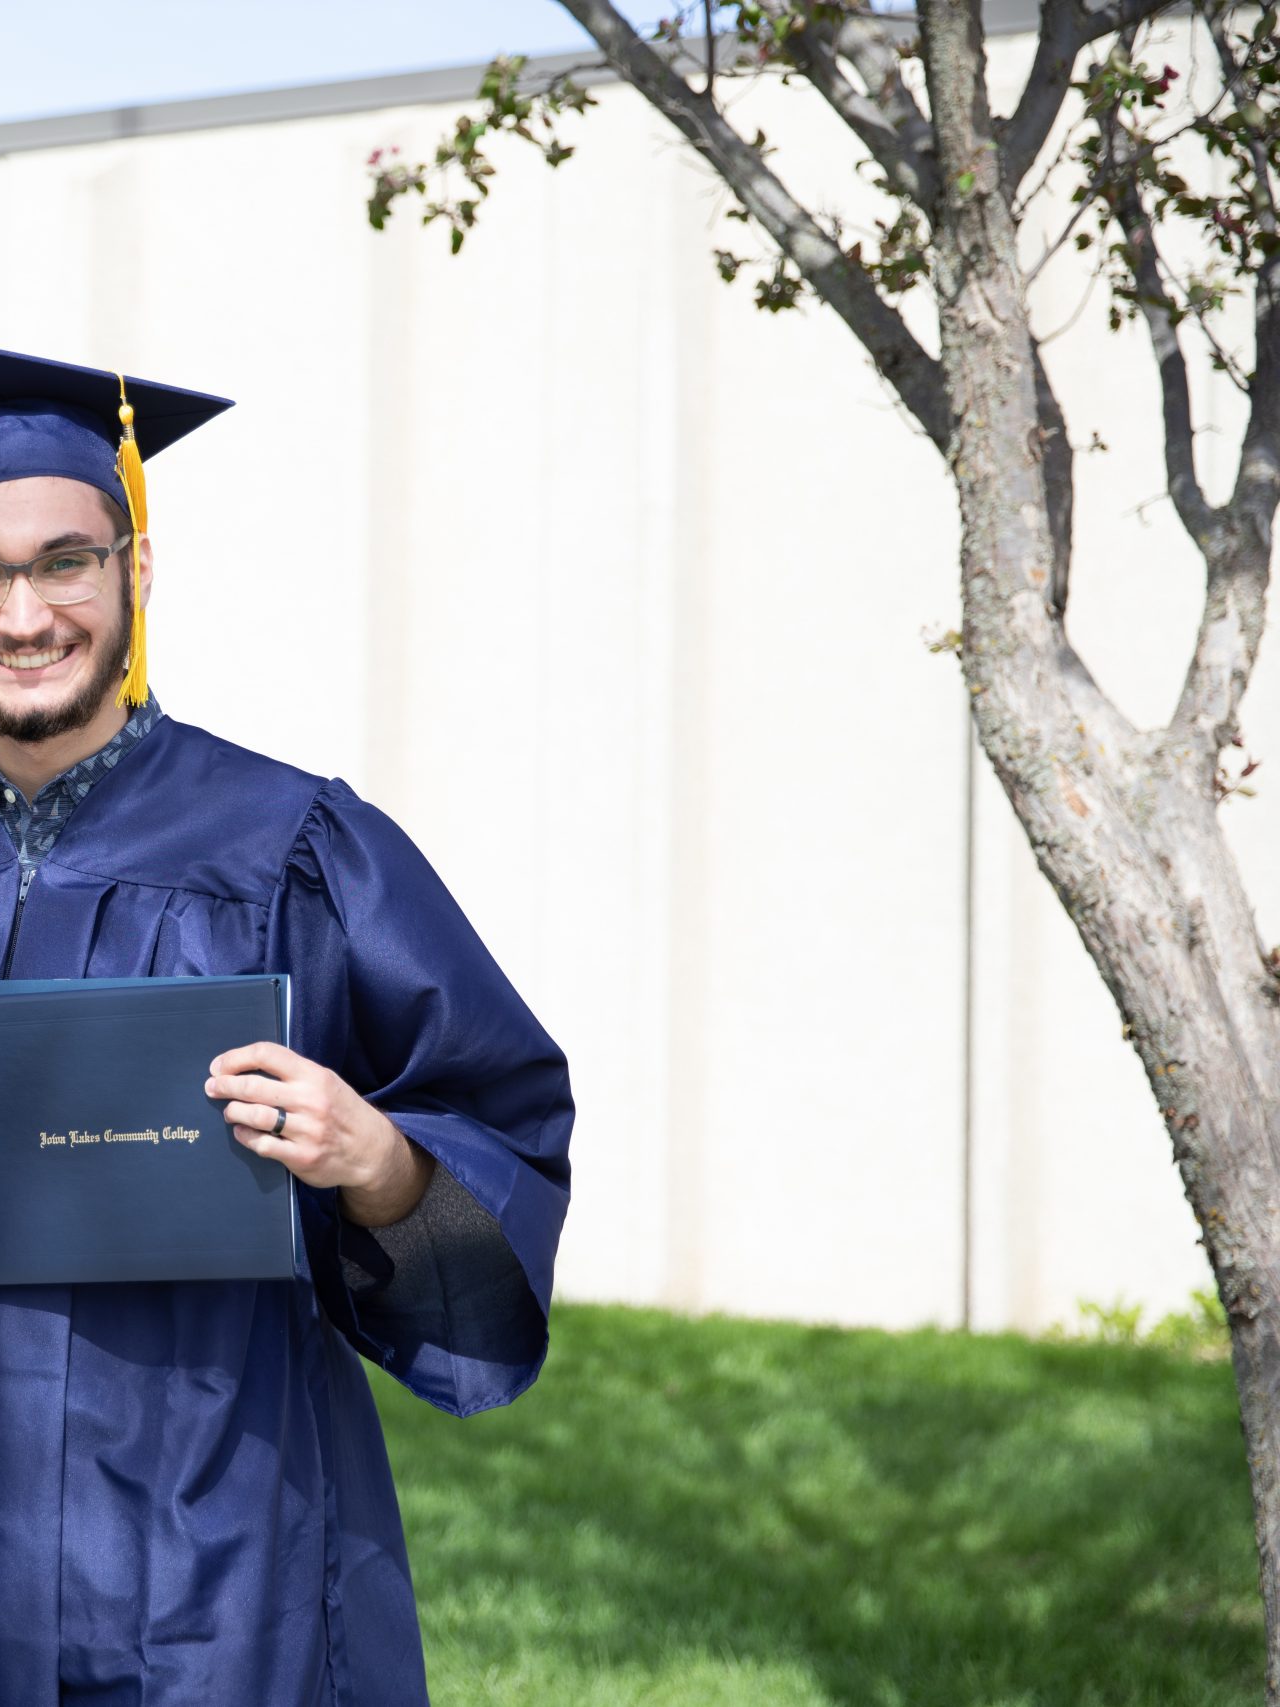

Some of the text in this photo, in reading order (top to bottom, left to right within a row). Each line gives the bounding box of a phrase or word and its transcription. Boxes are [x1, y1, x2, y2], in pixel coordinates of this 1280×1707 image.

[40, 1126, 200, 1149] Iowa Lakes Community College
